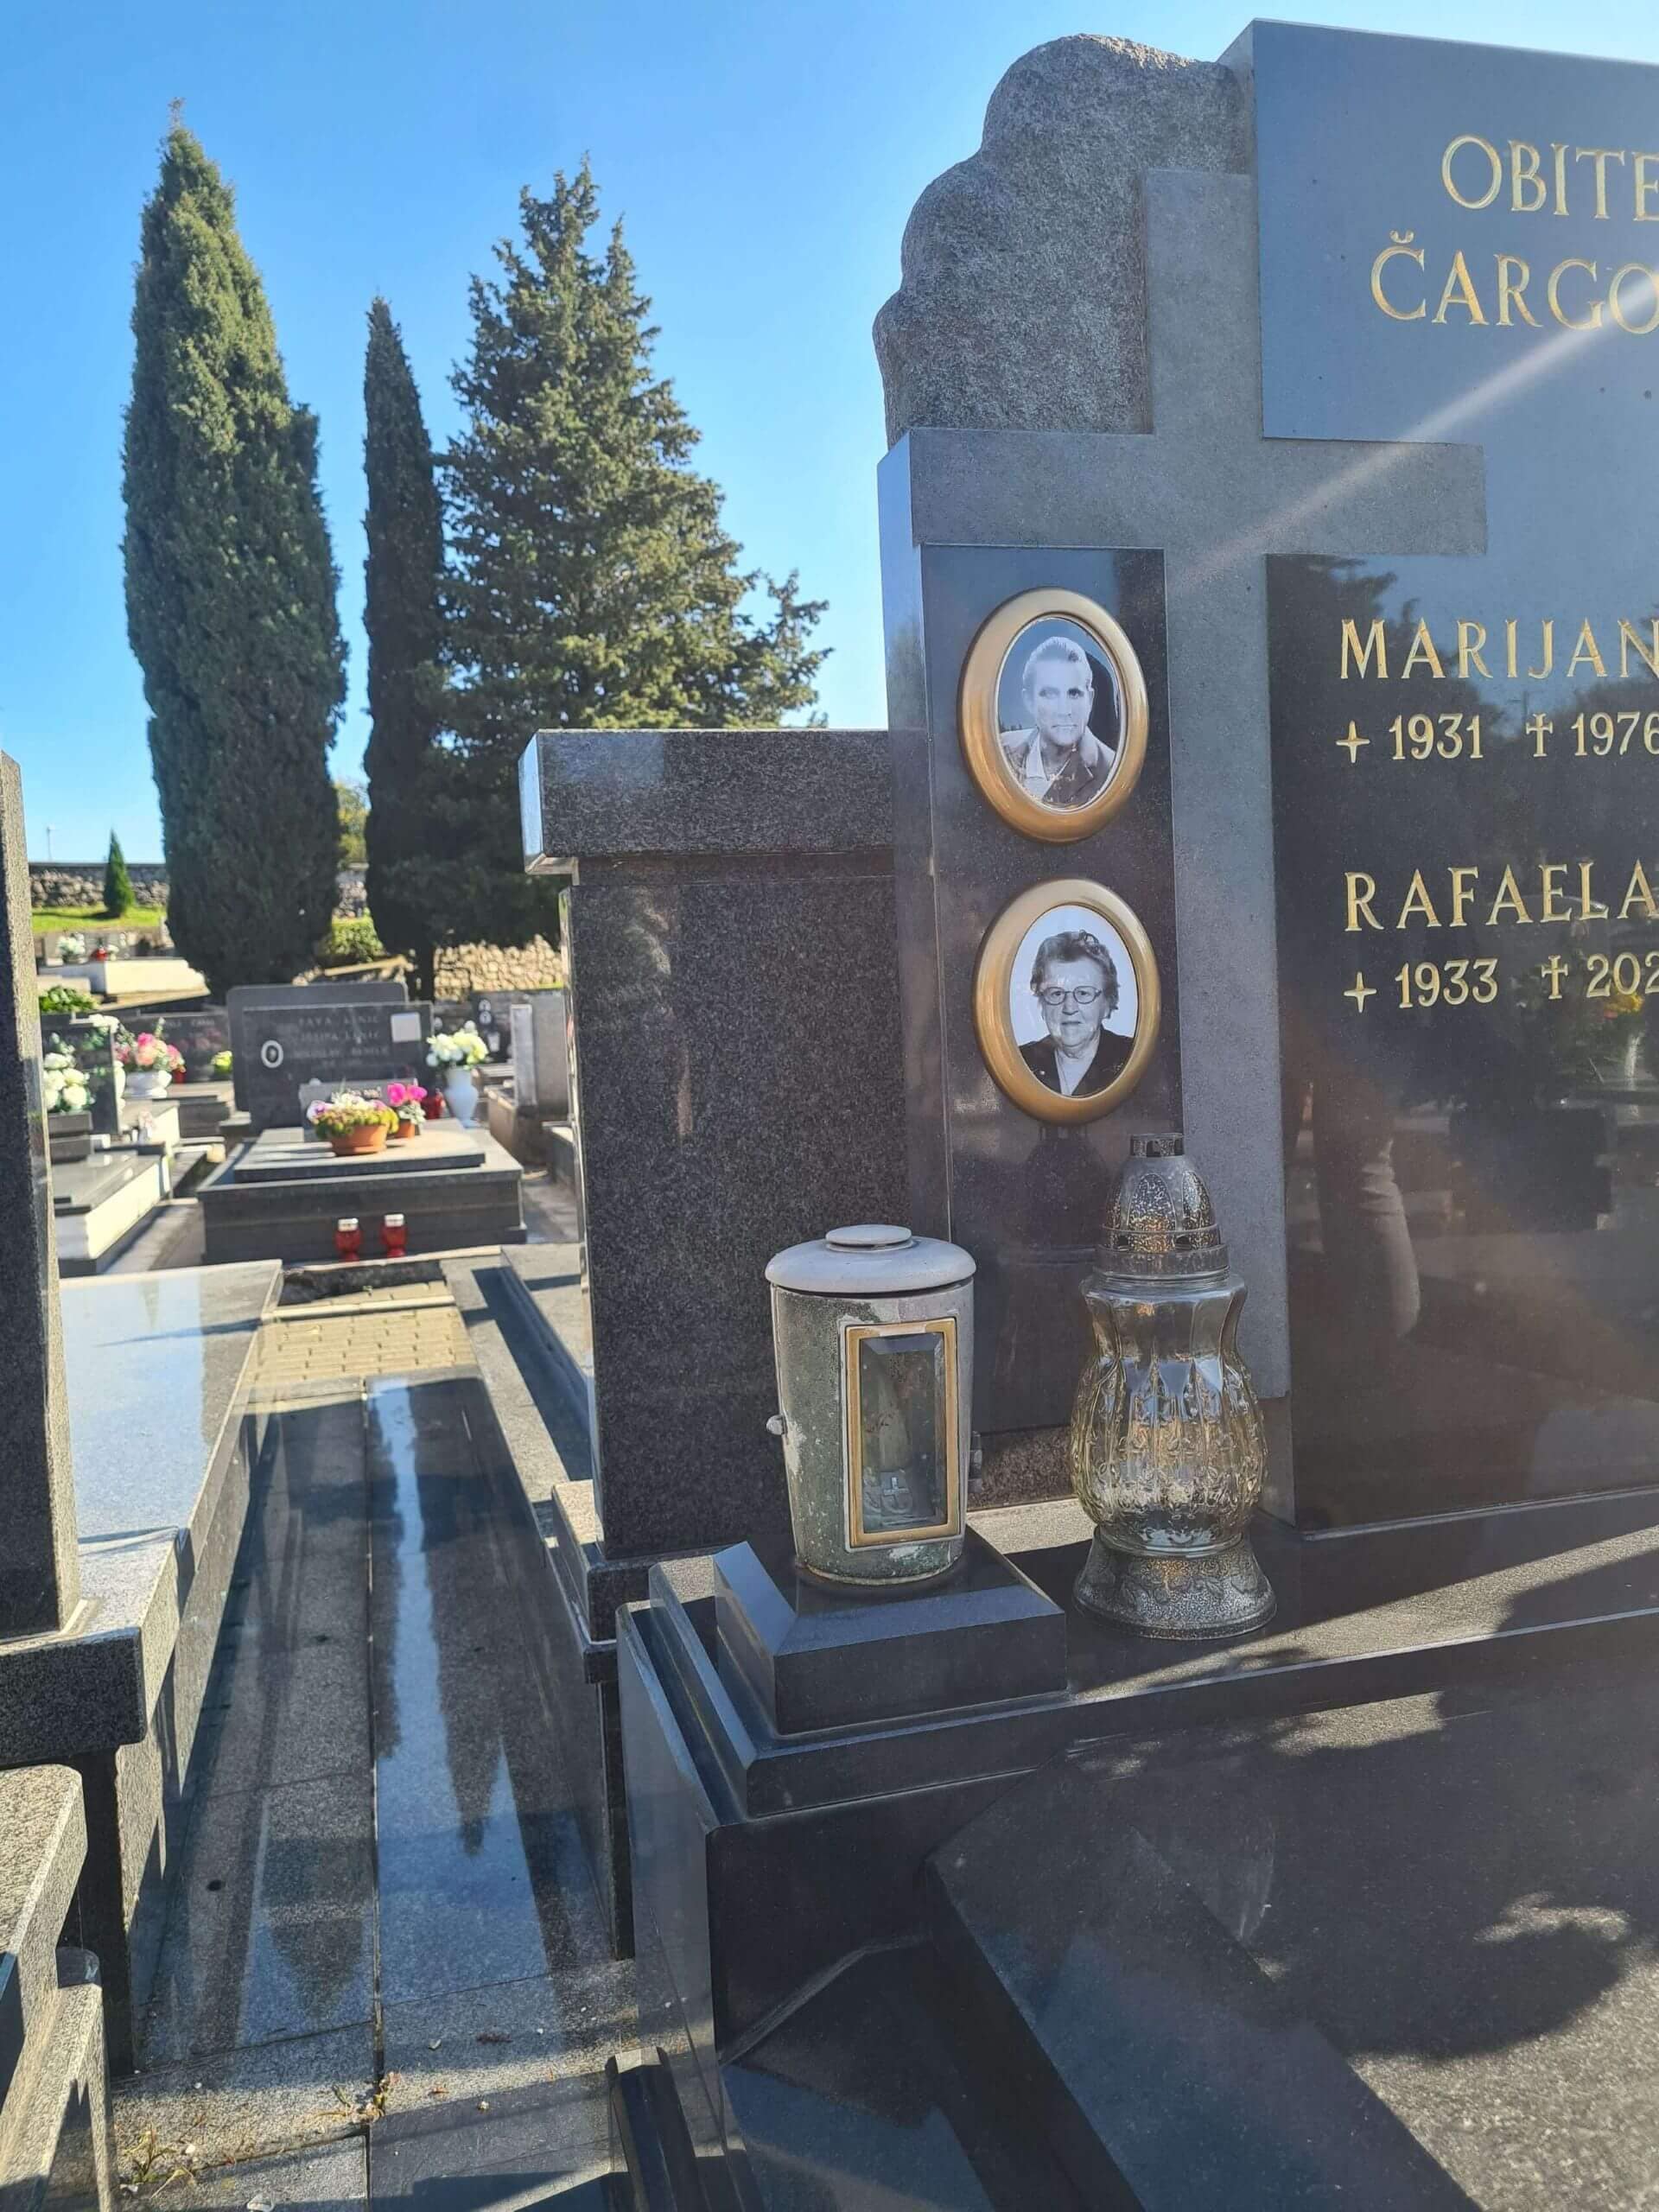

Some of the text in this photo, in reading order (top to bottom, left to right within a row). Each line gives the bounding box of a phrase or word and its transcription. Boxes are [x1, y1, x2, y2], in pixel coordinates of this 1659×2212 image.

[1441, 134, 1659, 221] OBITE
[1370, 229, 1659, 334] ČARGO
[1340, 617, 1659, 680] MARIJAN
[1389, 711, 1659, 760] 1931 1976
[1344, 859, 1659, 931] RAFAELA
[1395, 958, 1498, 1009] 1933
